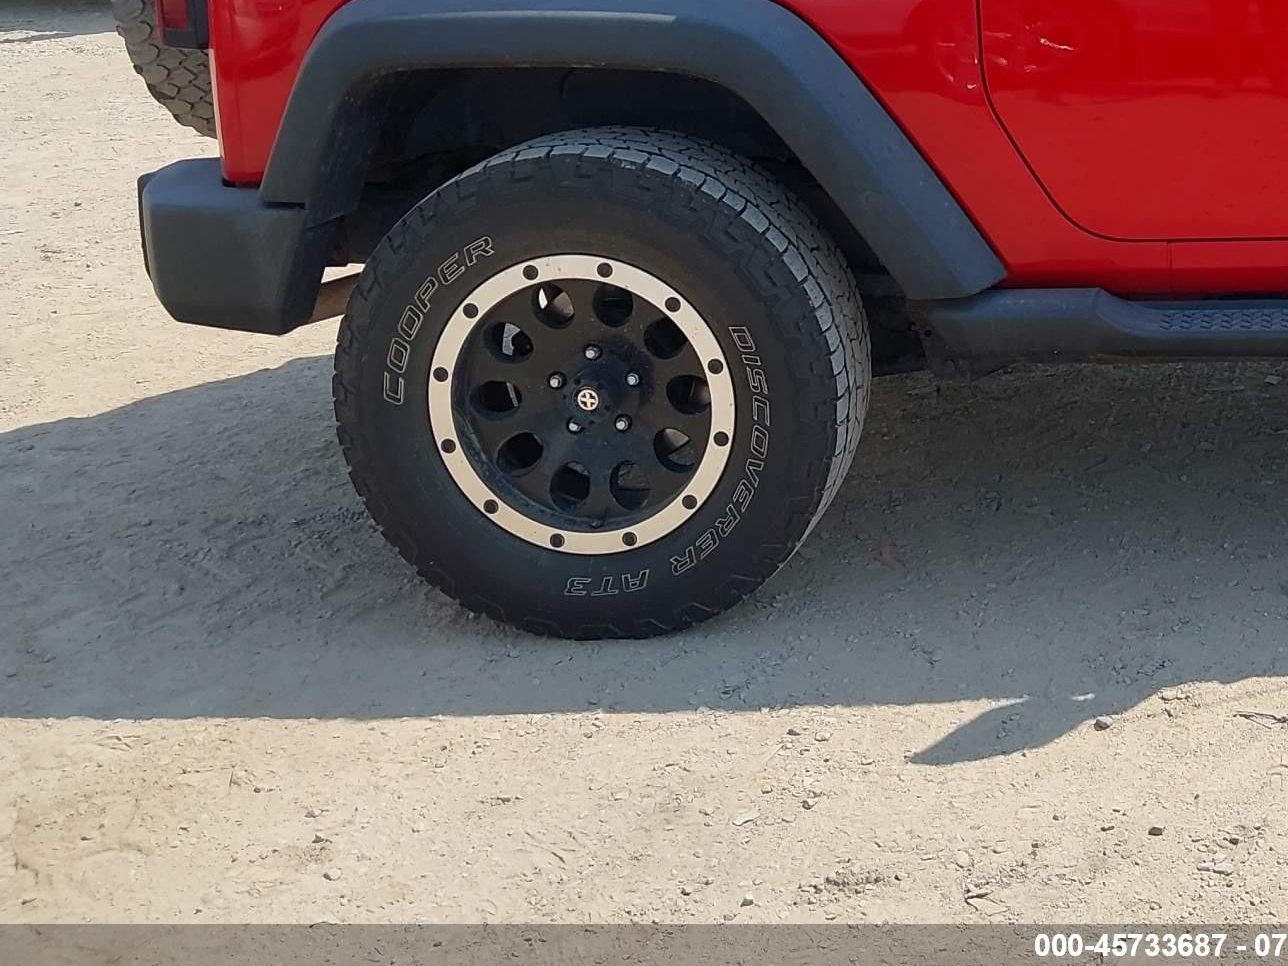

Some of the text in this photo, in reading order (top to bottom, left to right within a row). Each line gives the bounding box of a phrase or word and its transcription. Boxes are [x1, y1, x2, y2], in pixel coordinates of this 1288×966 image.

[383, 235, 495, 406] COOPER
[564, 325, 771, 597] DISCOVERER AT3
